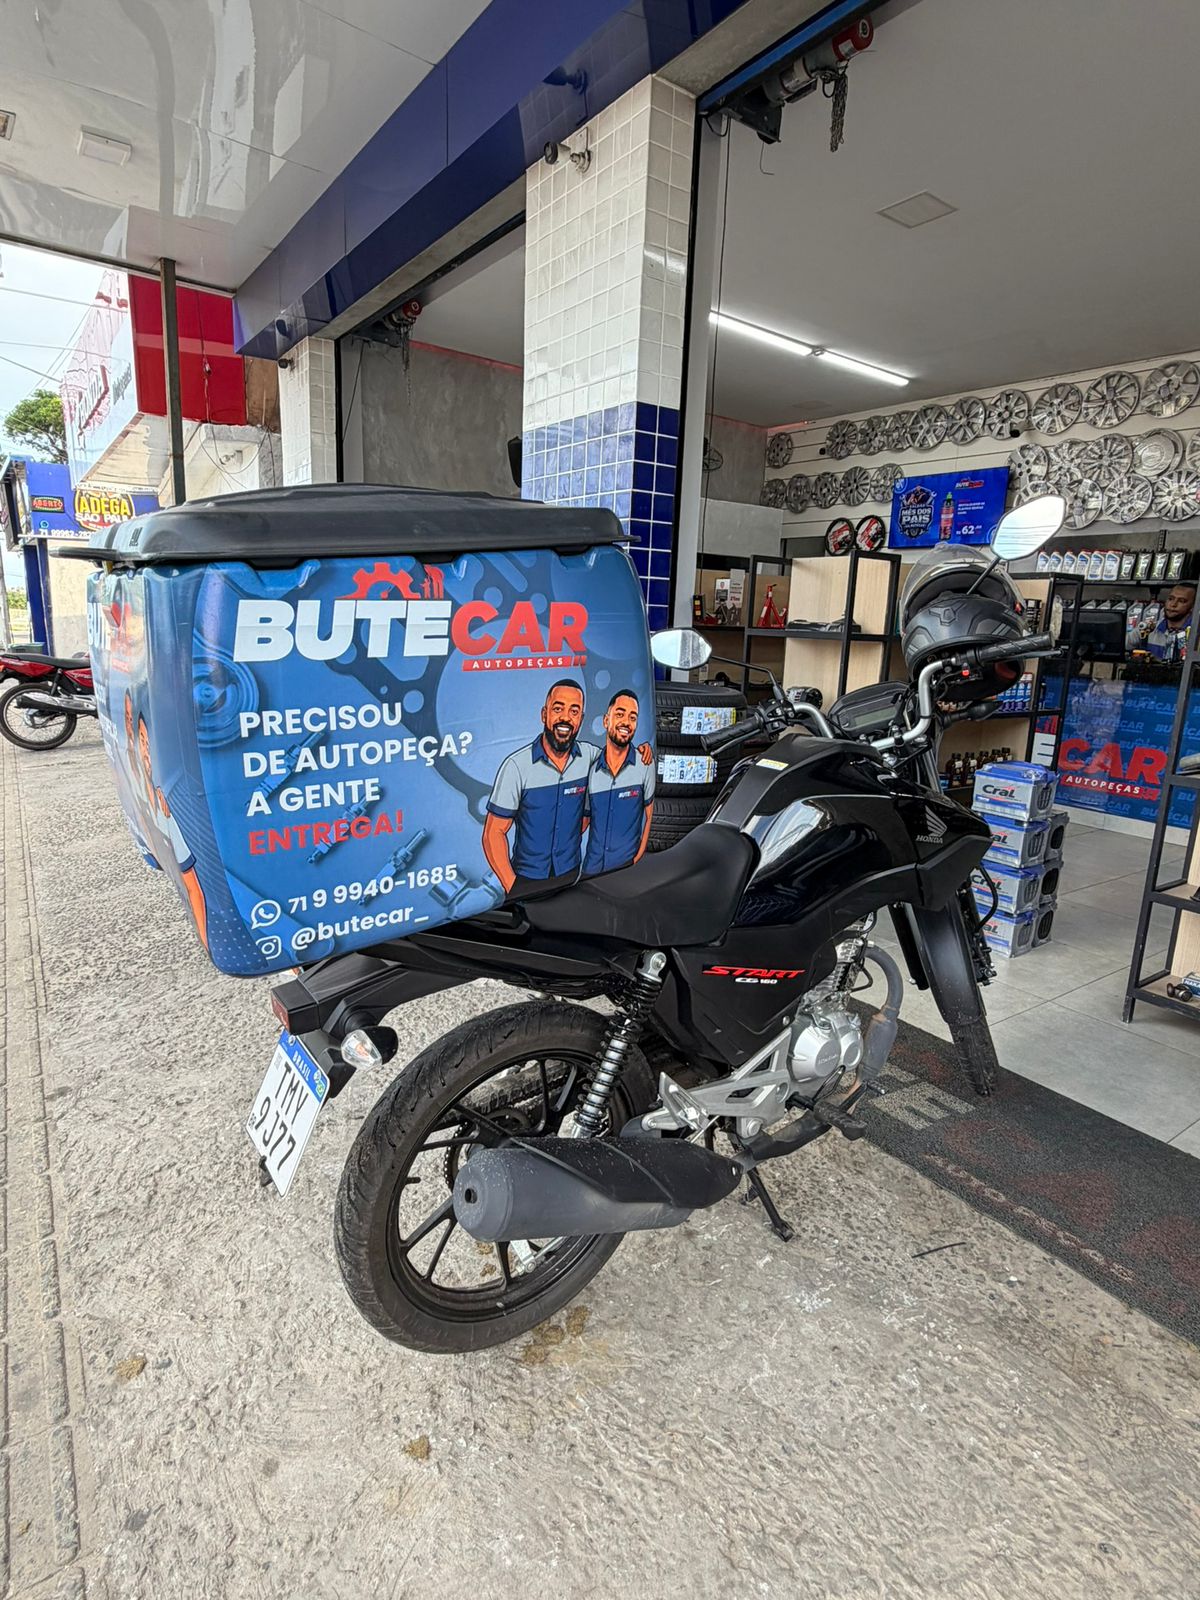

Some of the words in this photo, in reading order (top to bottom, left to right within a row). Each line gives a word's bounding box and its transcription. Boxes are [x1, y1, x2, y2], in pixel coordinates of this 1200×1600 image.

[79, 497, 131, 517] ADEGA
[962, 526, 975, 534] 62
[233, 599, 589, 662] BUTECAR
[472, 657, 565, 669] AUTOPEÇAS
[239, 702, 403, 738] PRECISOU
[243, 750, 287, 778] DE
[294, 732, 474, 773] AUTOPEÇA?
[246, 790, 273, 817] A
[279, 777, 381, 811] GENTE
[1066, 776, 1140, 793] AUTOPEÇAS
[249, 809, 405, 855] ENTREGA!
[915, 835, 943, 844] HONDA
[288, 896, 308, 915] 71
[313, 889, 328, 909] 9
[333, 863, 458, 905] 9940-1685
[291, 903, 430, 951] @butecar_
[702, 965, 806, 979] START
[292, 1050, 311, 1081] BRASIL
[275, 1061, 309, 1125] TMY
[254, 1096, 297, 1171] 9J77
